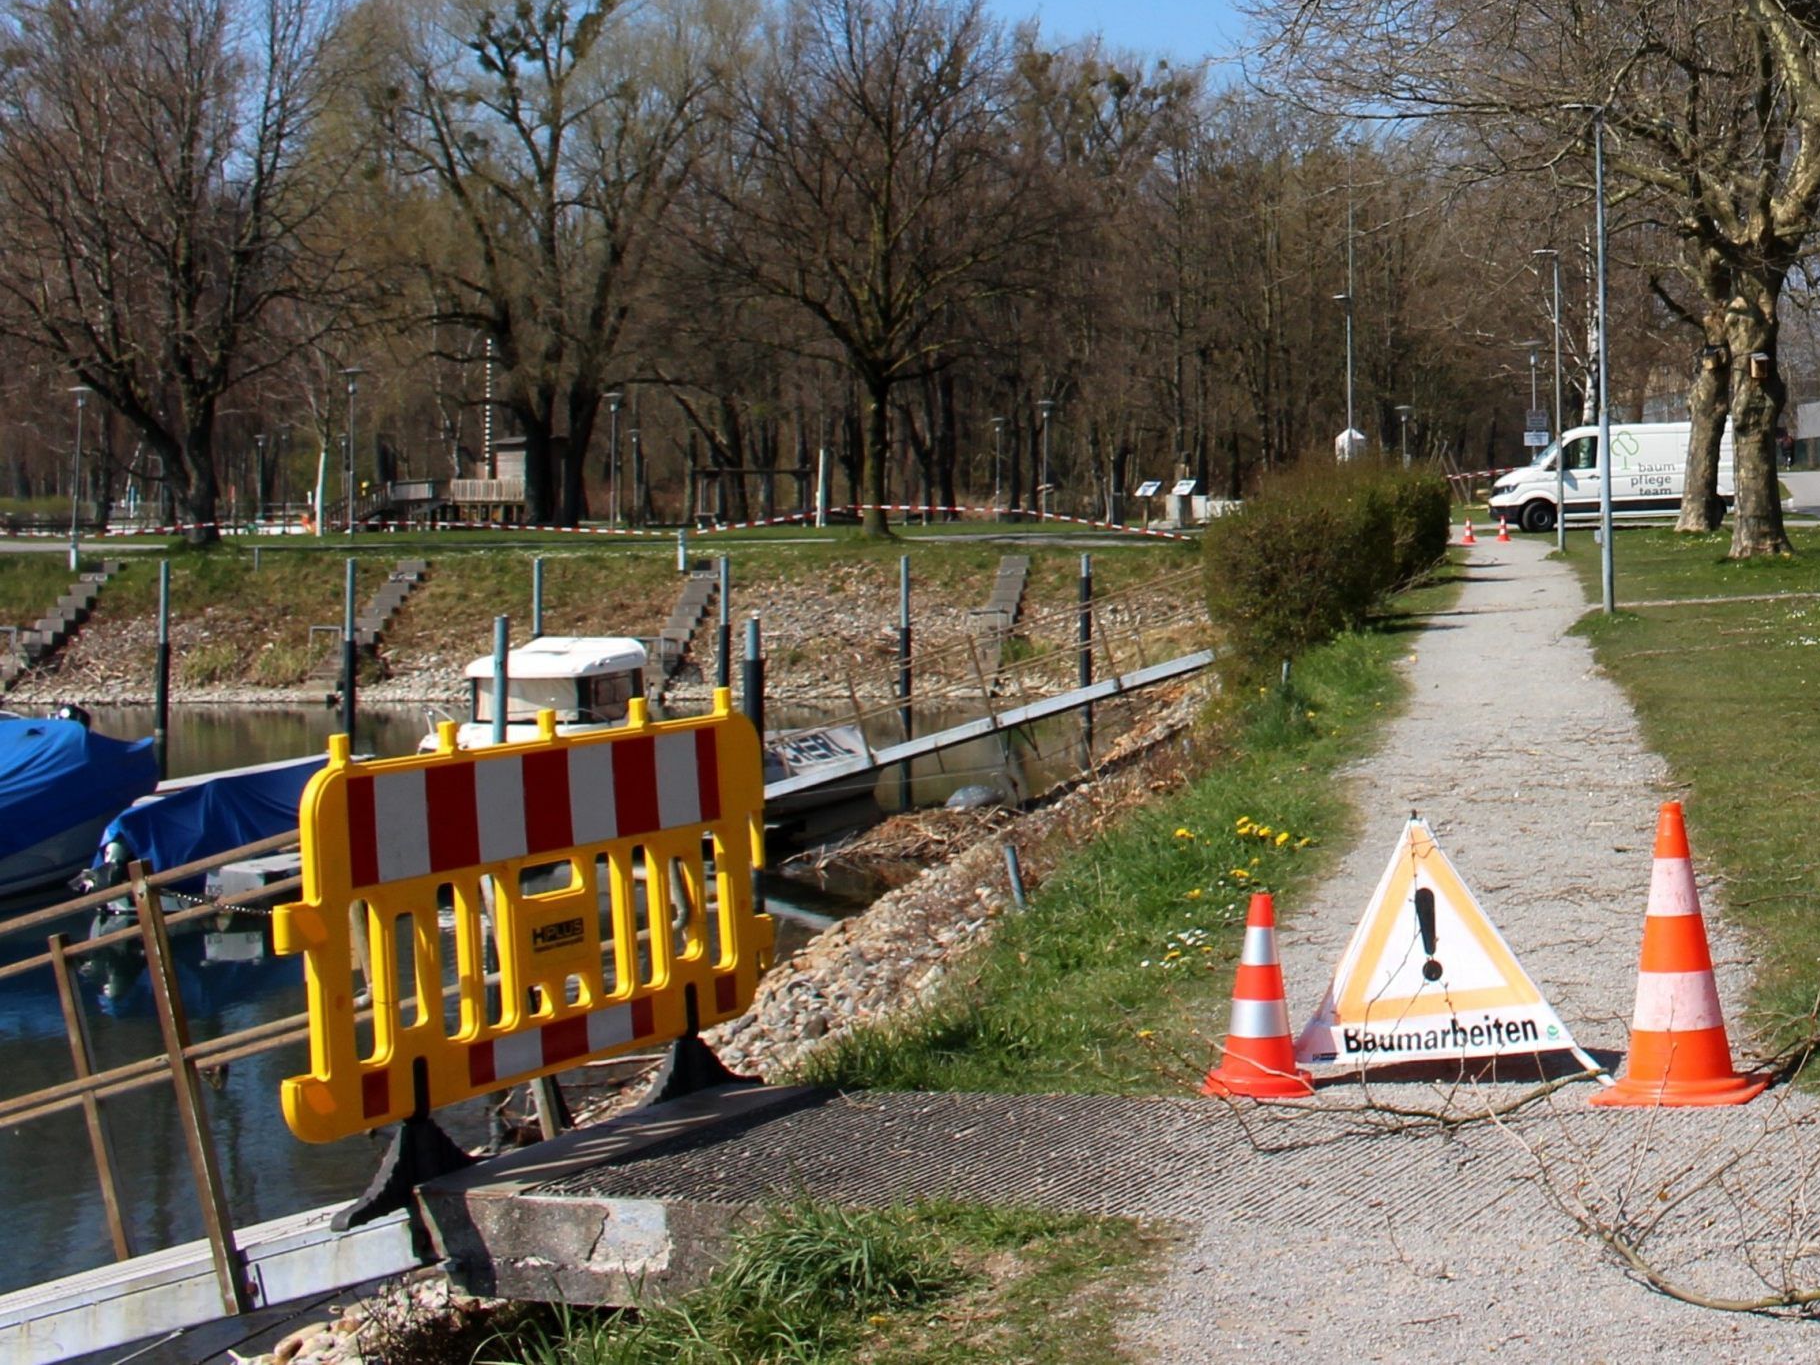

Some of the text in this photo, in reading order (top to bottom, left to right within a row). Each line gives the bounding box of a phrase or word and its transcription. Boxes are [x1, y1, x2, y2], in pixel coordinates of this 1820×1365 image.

[1638, 462, 1676, 473] baum
[1631, 474, 1672, 487] pflege
[1639, 487, 1672, 496] team
[1344, 1015, 1538, 1054] Baumarbeiten
